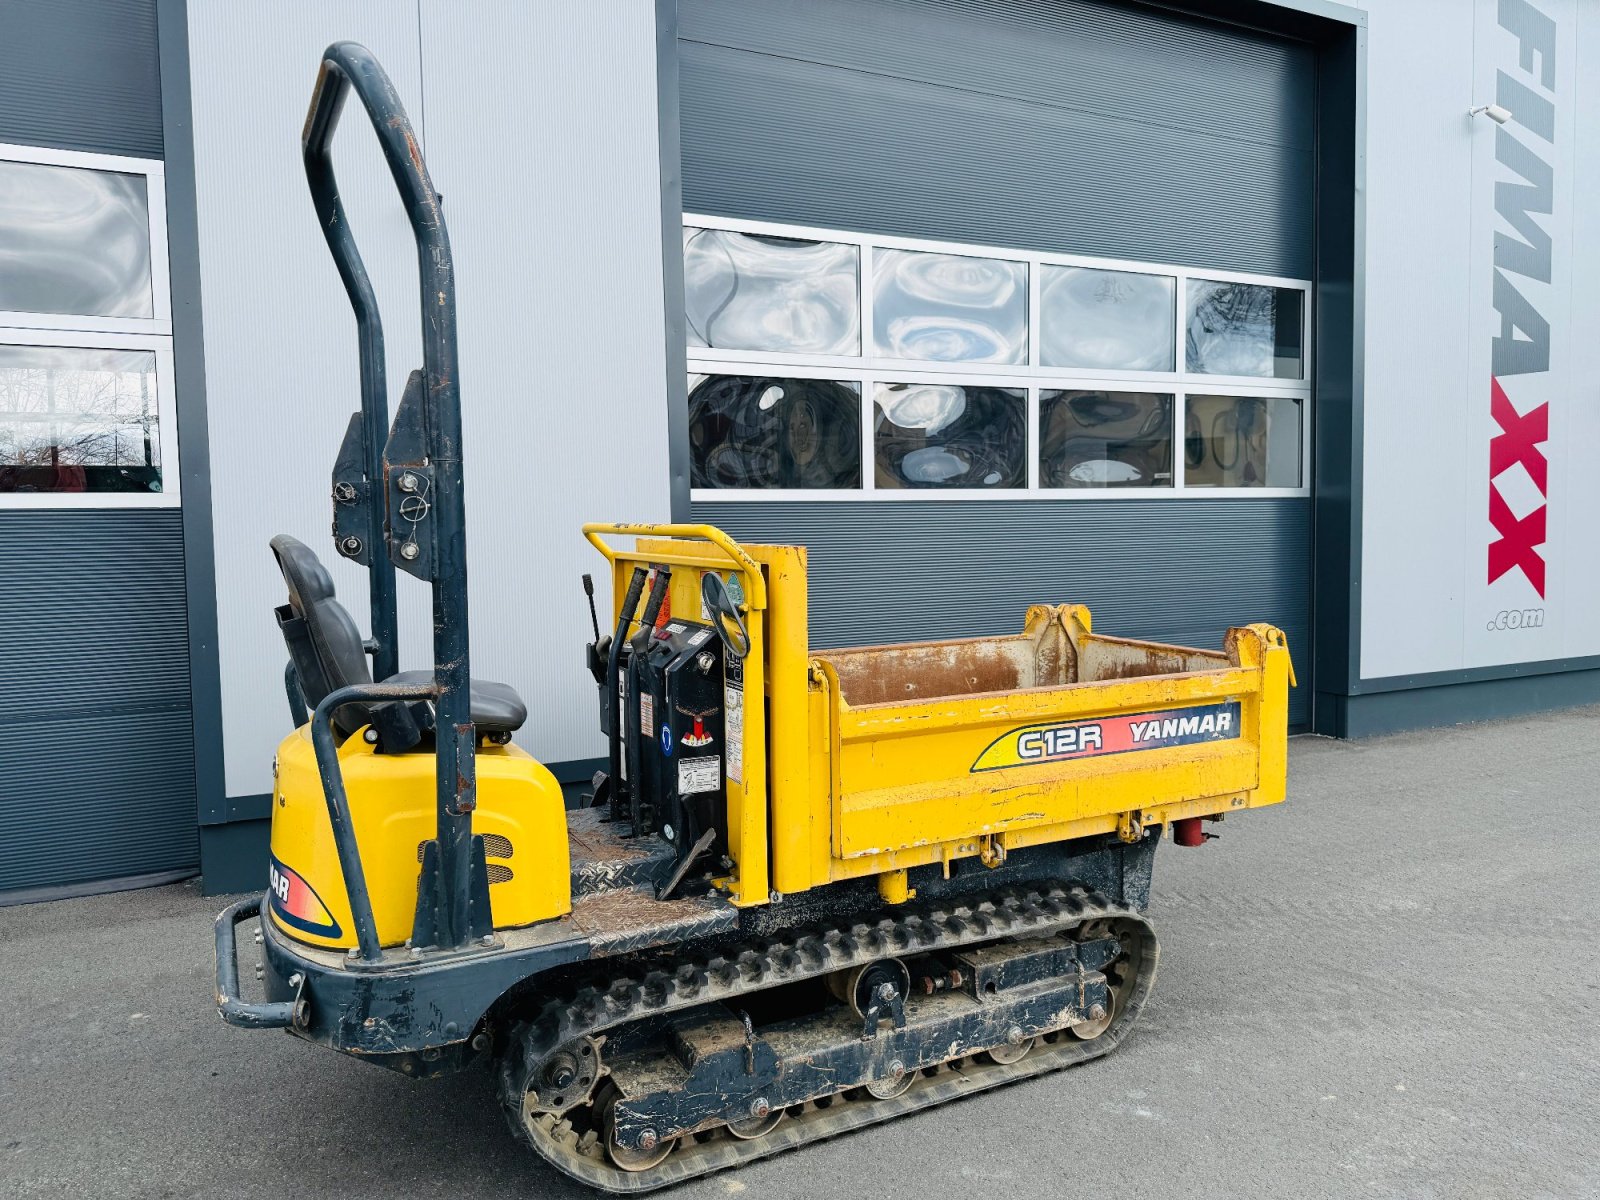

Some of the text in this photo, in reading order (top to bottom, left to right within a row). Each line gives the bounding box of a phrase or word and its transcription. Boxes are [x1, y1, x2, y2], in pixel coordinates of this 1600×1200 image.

[1487, 0, 1557, 601] FIMAXX
[1486, 608, 1544, 631] .com
[1018, 712, 1232, 757] C12R YANMAR
